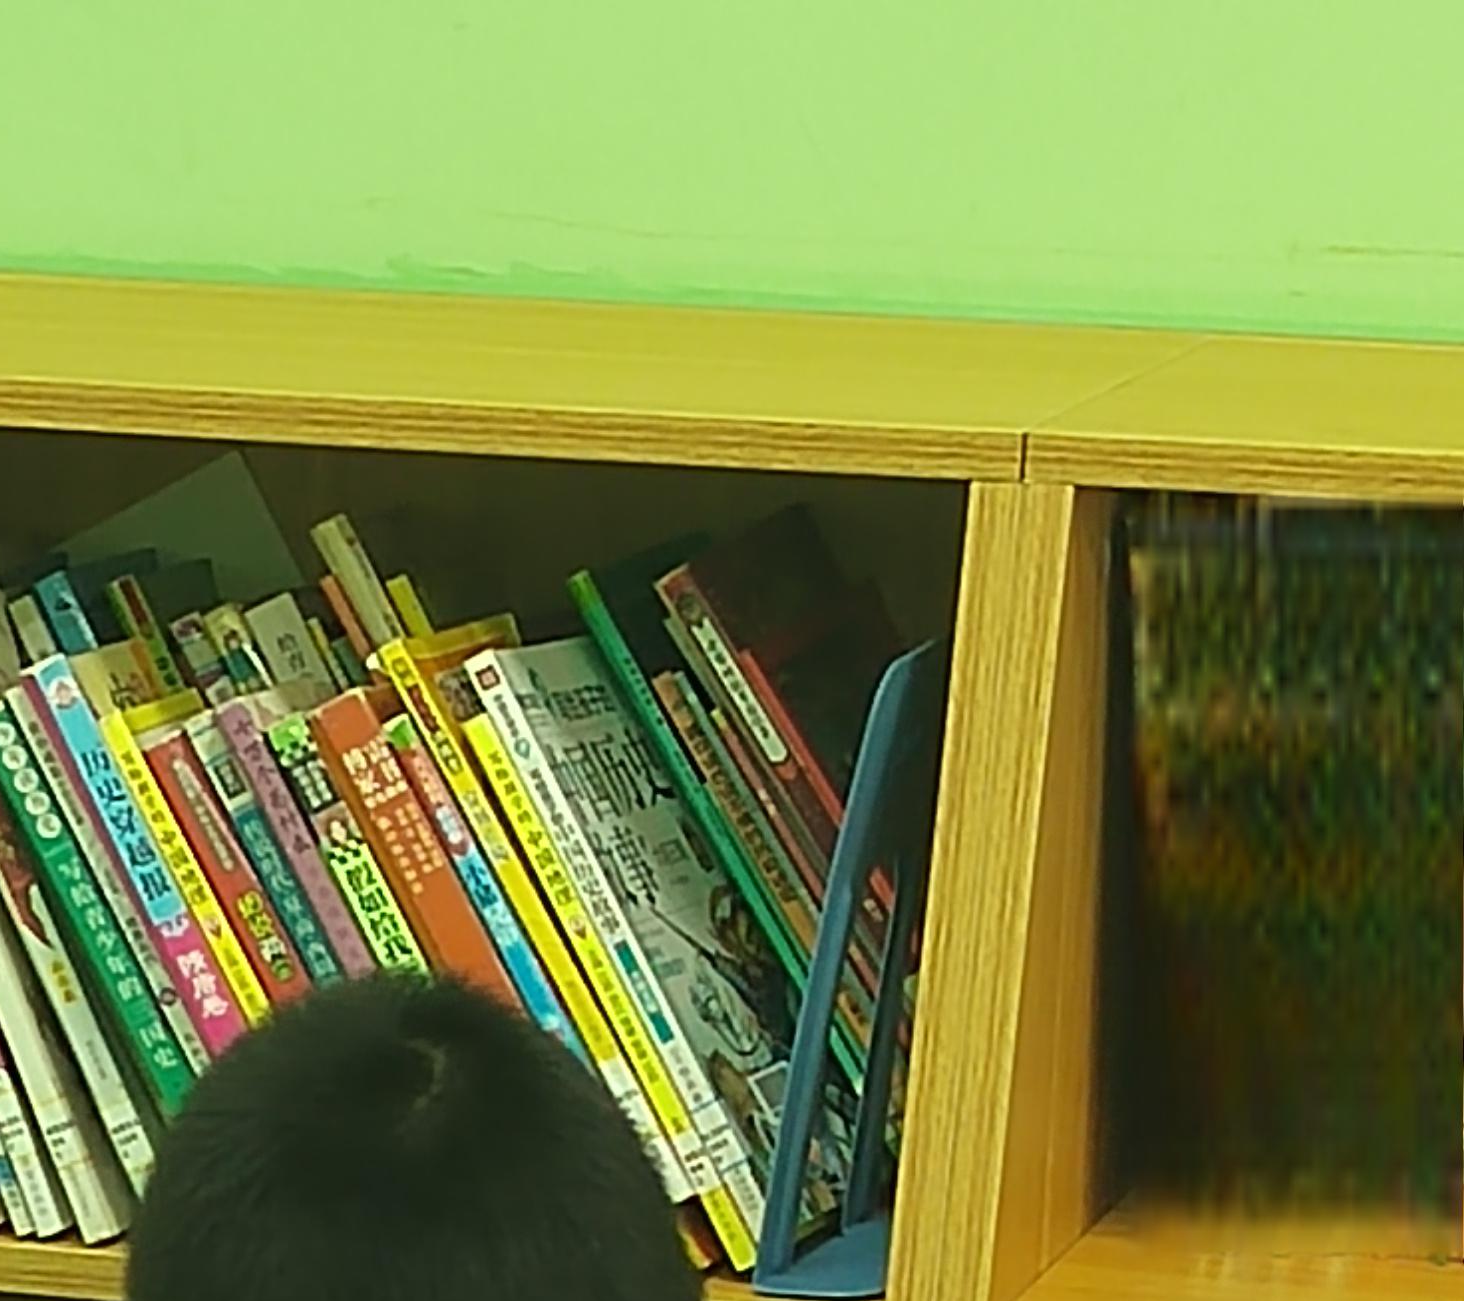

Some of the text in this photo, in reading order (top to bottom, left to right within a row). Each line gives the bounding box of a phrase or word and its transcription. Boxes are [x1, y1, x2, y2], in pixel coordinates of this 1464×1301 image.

[81, 750, 172, 902] 历史穿越报
